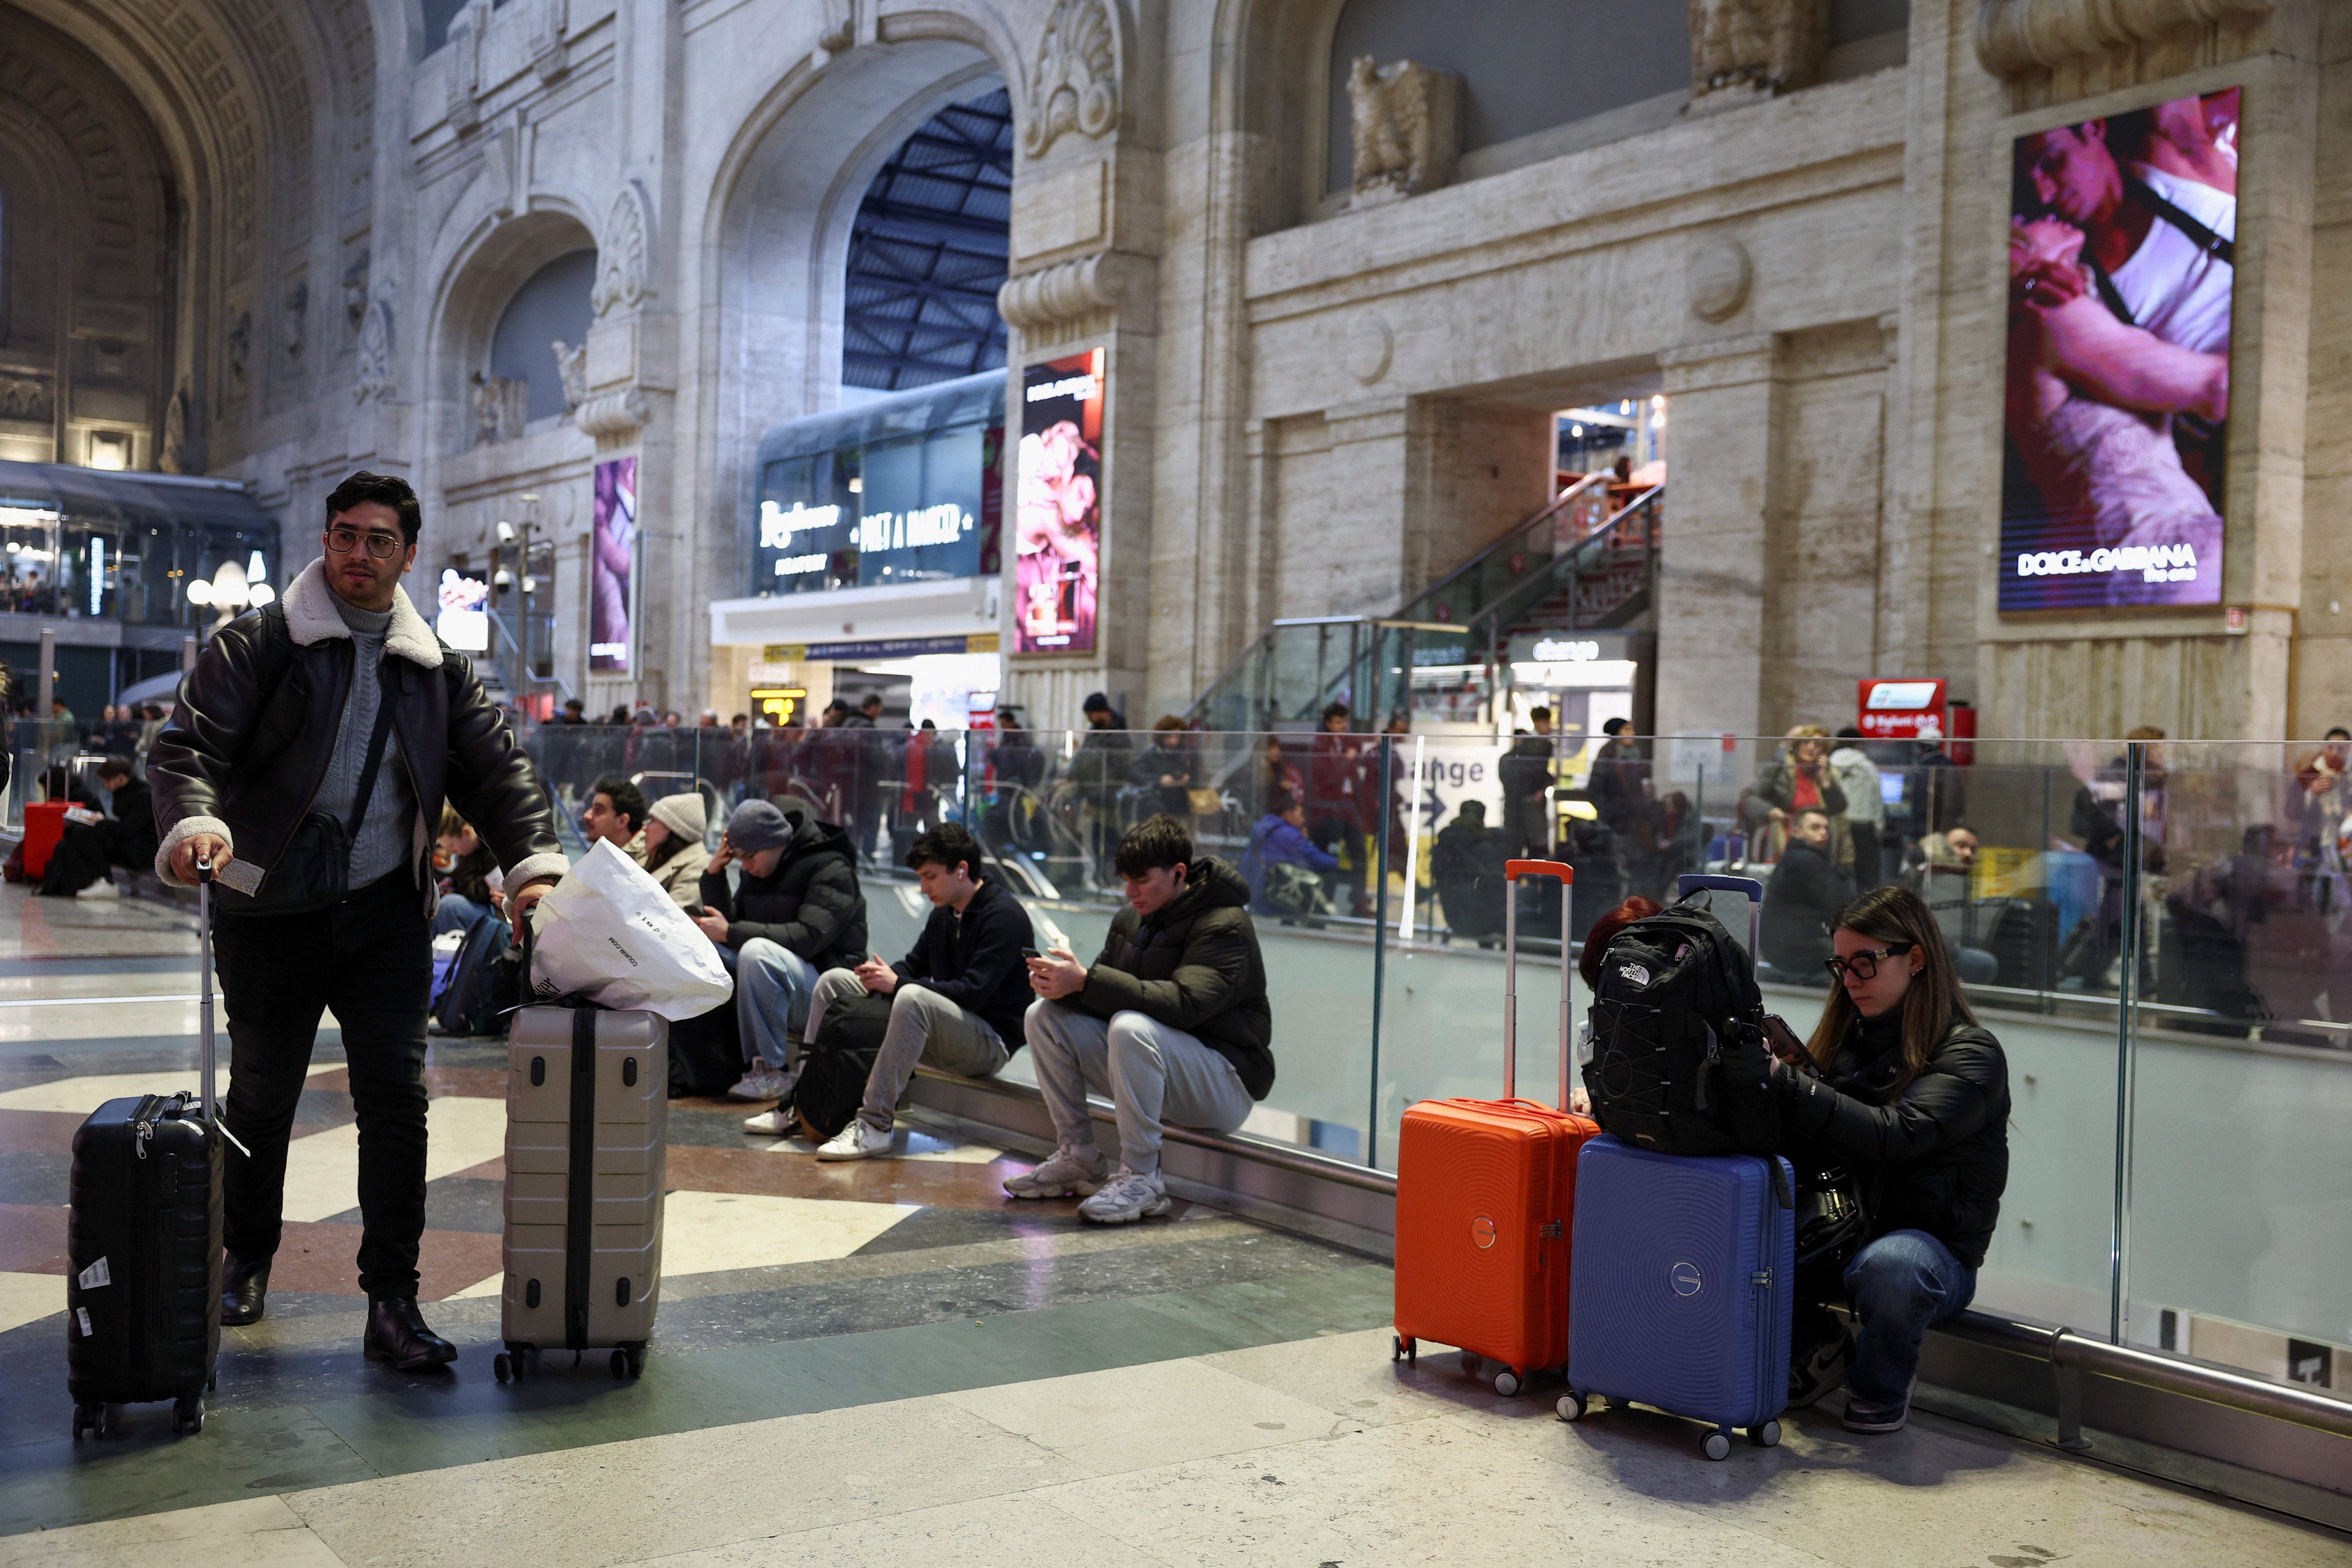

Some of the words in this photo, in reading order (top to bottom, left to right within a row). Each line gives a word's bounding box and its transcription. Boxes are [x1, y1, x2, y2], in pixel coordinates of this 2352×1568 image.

[609, 936, 638, 967] COURIR.COM
[1619, 966, 1640, 976] NORTH
[1630, 963, 1642, 972] THE
[1621, 972, 1637, 981] FACE
